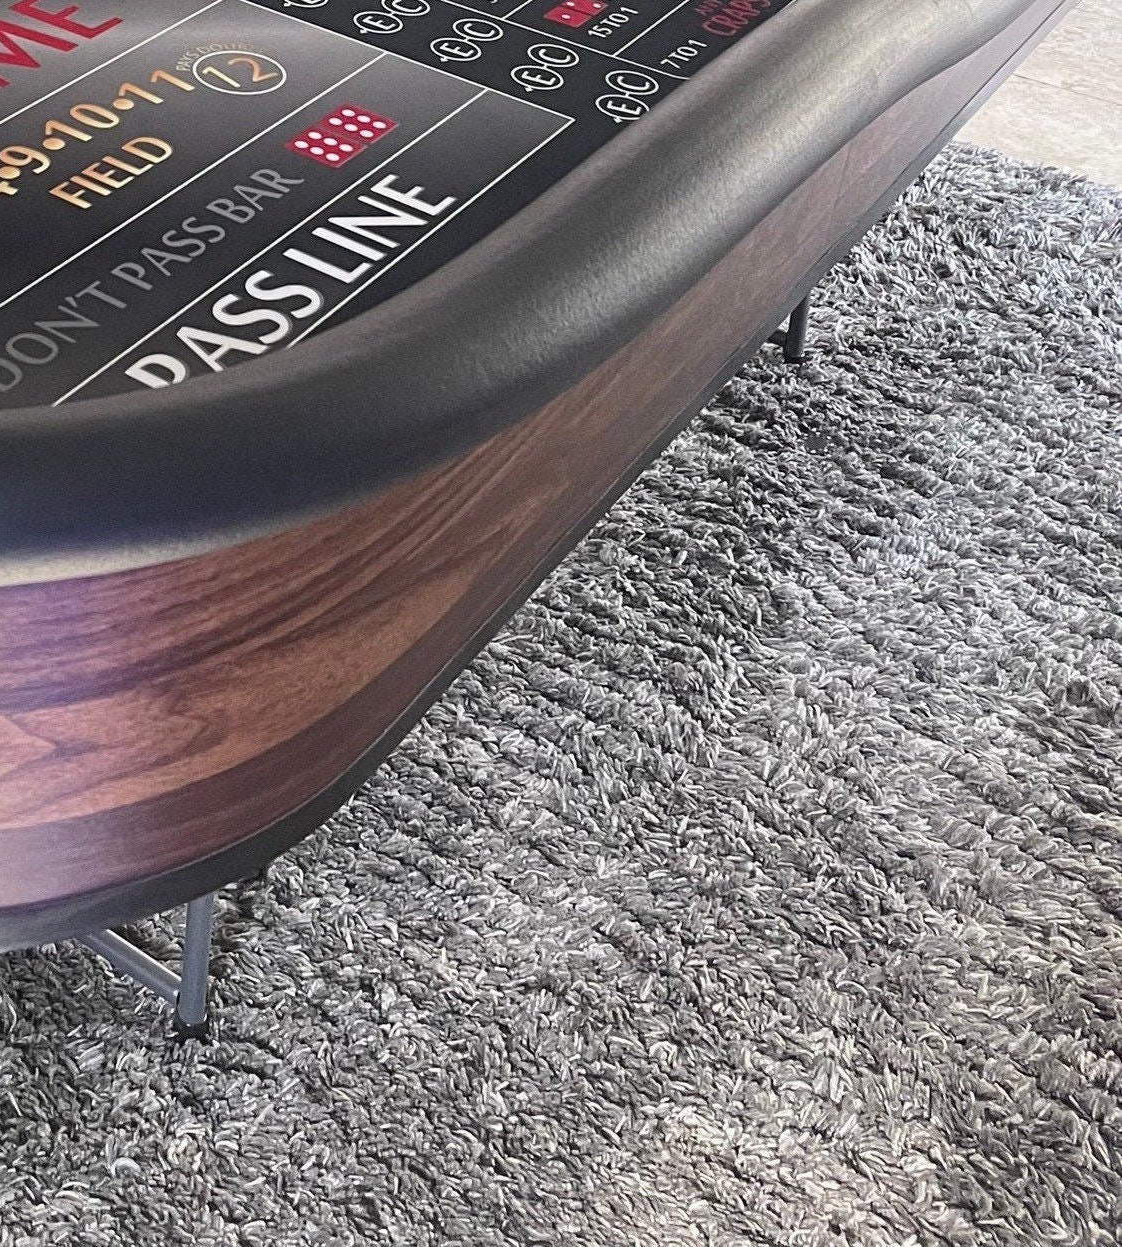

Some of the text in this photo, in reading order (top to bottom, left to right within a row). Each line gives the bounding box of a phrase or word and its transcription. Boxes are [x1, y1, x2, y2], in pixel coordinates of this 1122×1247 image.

[201, 56, 278, 88] 12
[49, 136, 173, 209] FIELD
[110, 216, 226, 291] PASS
[205, 168, 305, 223] BAR
[282, 174, 458, 284] LINE
